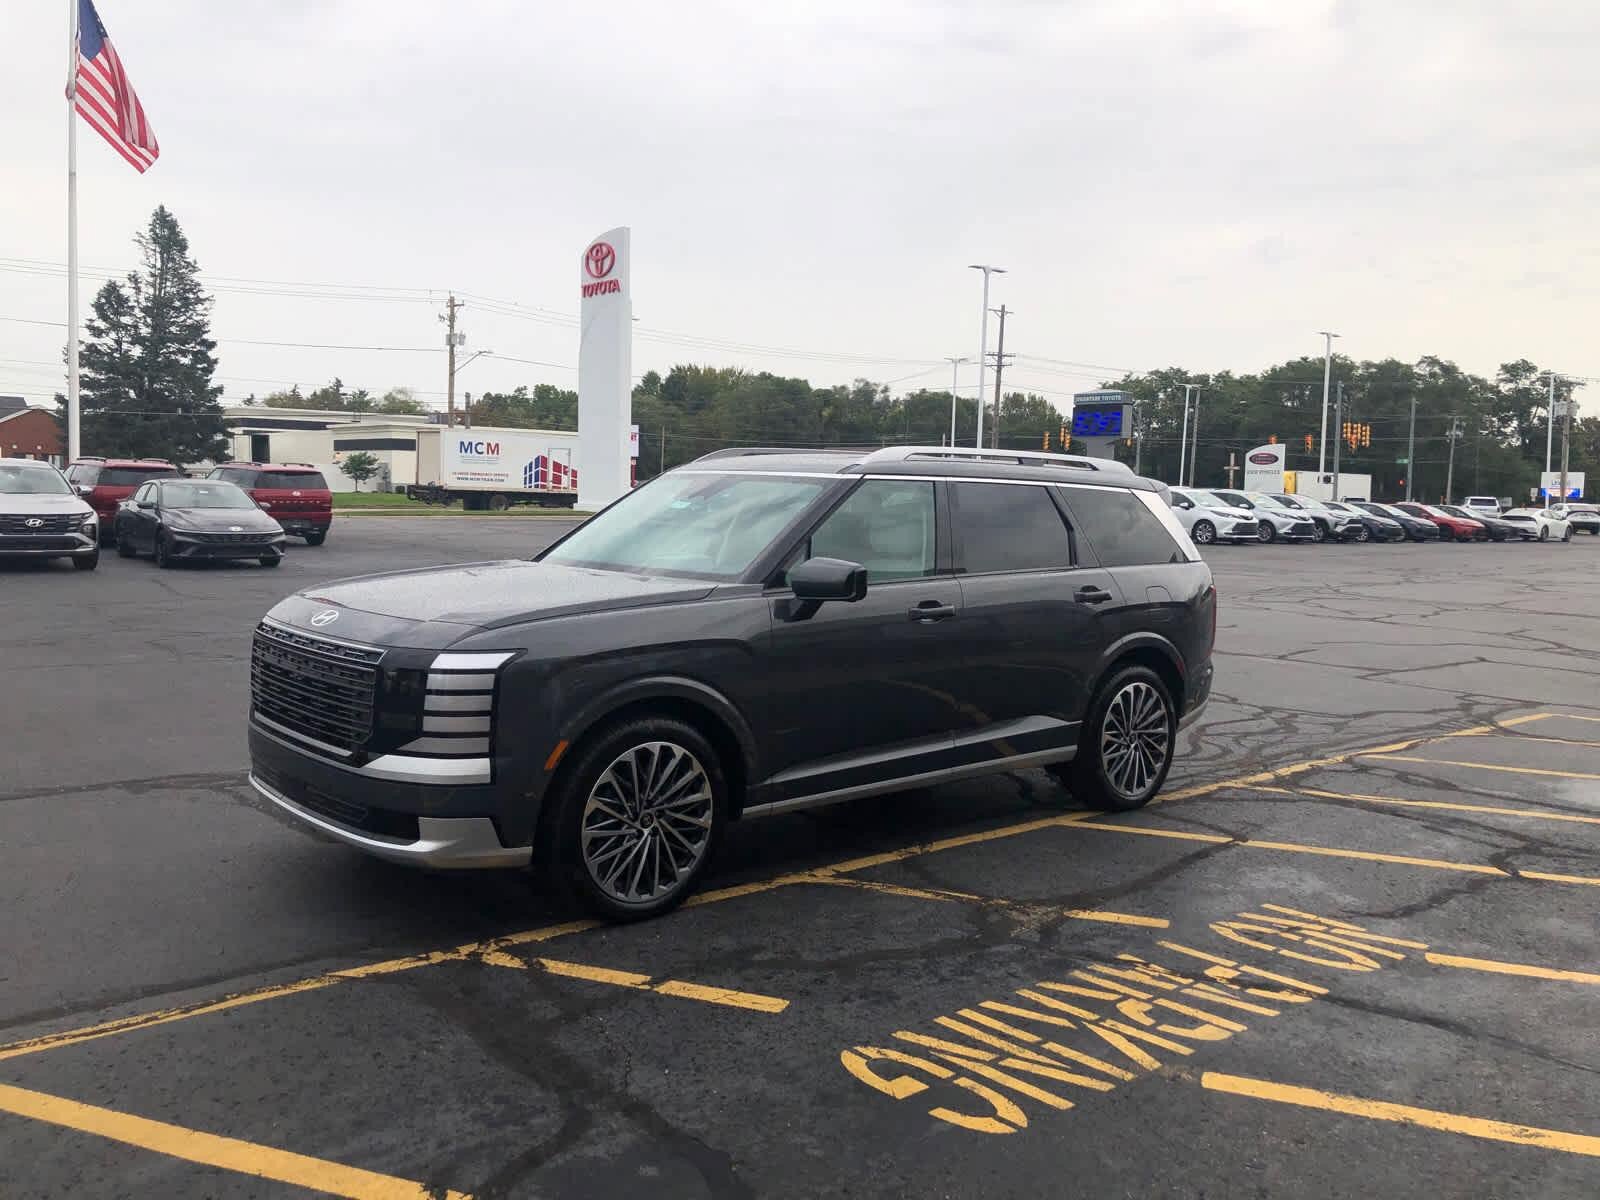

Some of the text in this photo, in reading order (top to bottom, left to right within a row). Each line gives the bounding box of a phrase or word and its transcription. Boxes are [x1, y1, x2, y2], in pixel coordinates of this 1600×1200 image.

[581, 279, 621, 298] TOYOTA
[459, 440, 500, 455] MCM
[839, 903, 1430, 1134] NO PARKING
